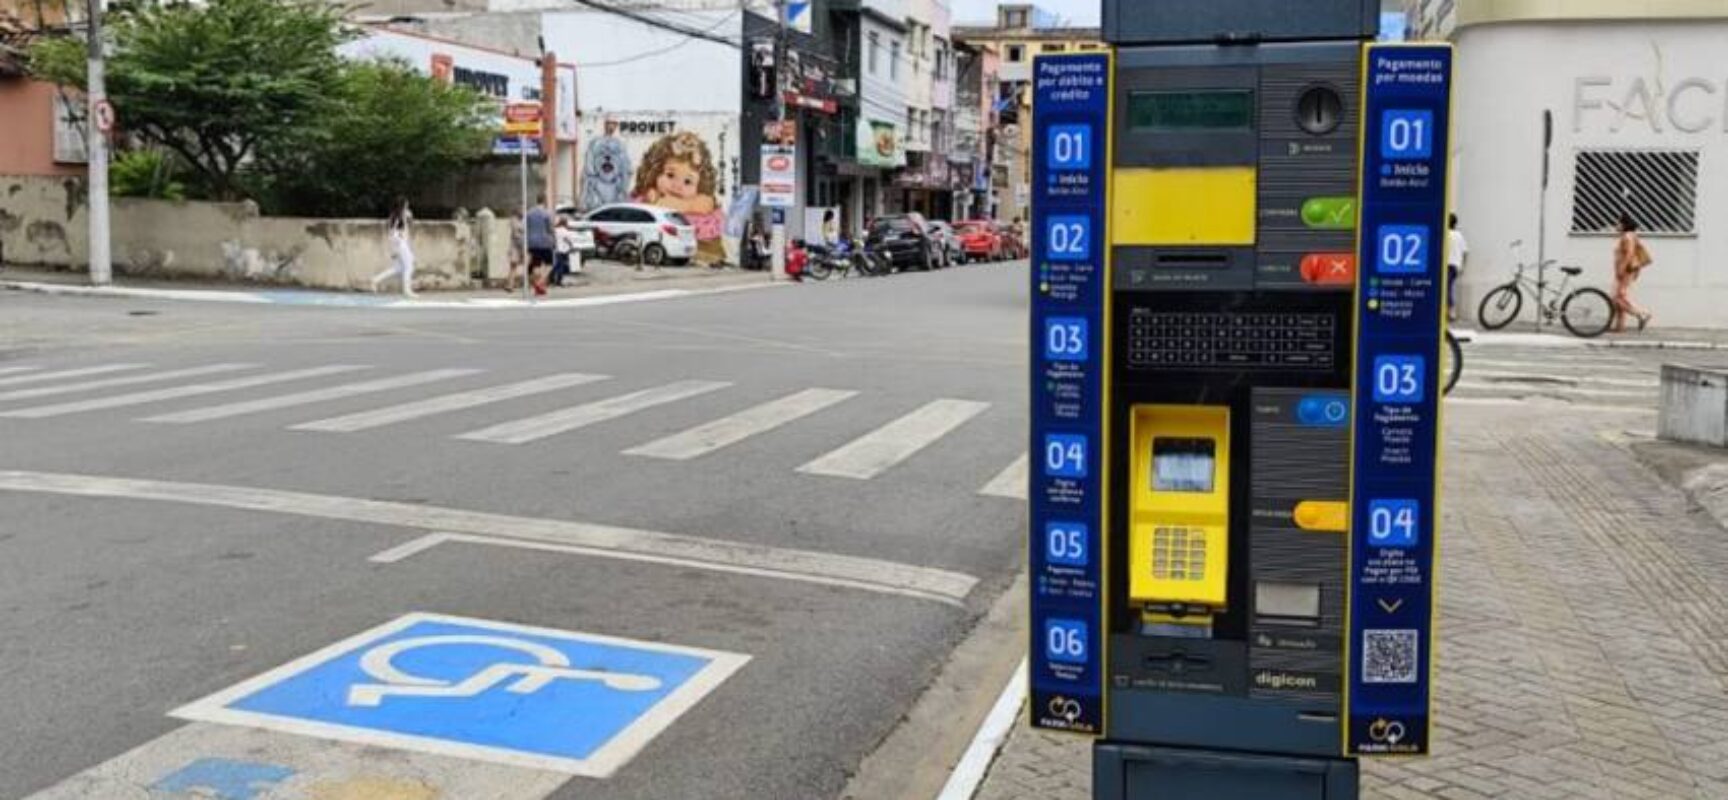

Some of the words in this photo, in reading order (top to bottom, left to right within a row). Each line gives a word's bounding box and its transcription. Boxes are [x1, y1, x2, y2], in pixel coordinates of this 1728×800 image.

[1040, 62, 1102, 75] Pagamento
[1375, 74, 1396, 85] por
[1398, 72, 1443, 82] moedas
[1377, 58, 1443, 72] Pagamento
[1038, 78, 1056, 89] por
[1571, 76, 1728, 133] FAC
[618, 120, 676, 133] PROVET
[1389, 117, 1424, 151] 01
[1054, 131, 1084, 162] 01
[1050, 222, 1085, 253] 02
[1382, 232, 1422, 267] 02
[1049, 324, 1083, 354] 03
[1378, 363, 1418, 396] 03
[1048, 441, 1083, 471] 04
[1371, 507, 1415, 539] 04
[1050, 528, 1083, 558] 05
[1049, 625, 1084, 656] 06
[1255, 671, 1317, 688] digicon
